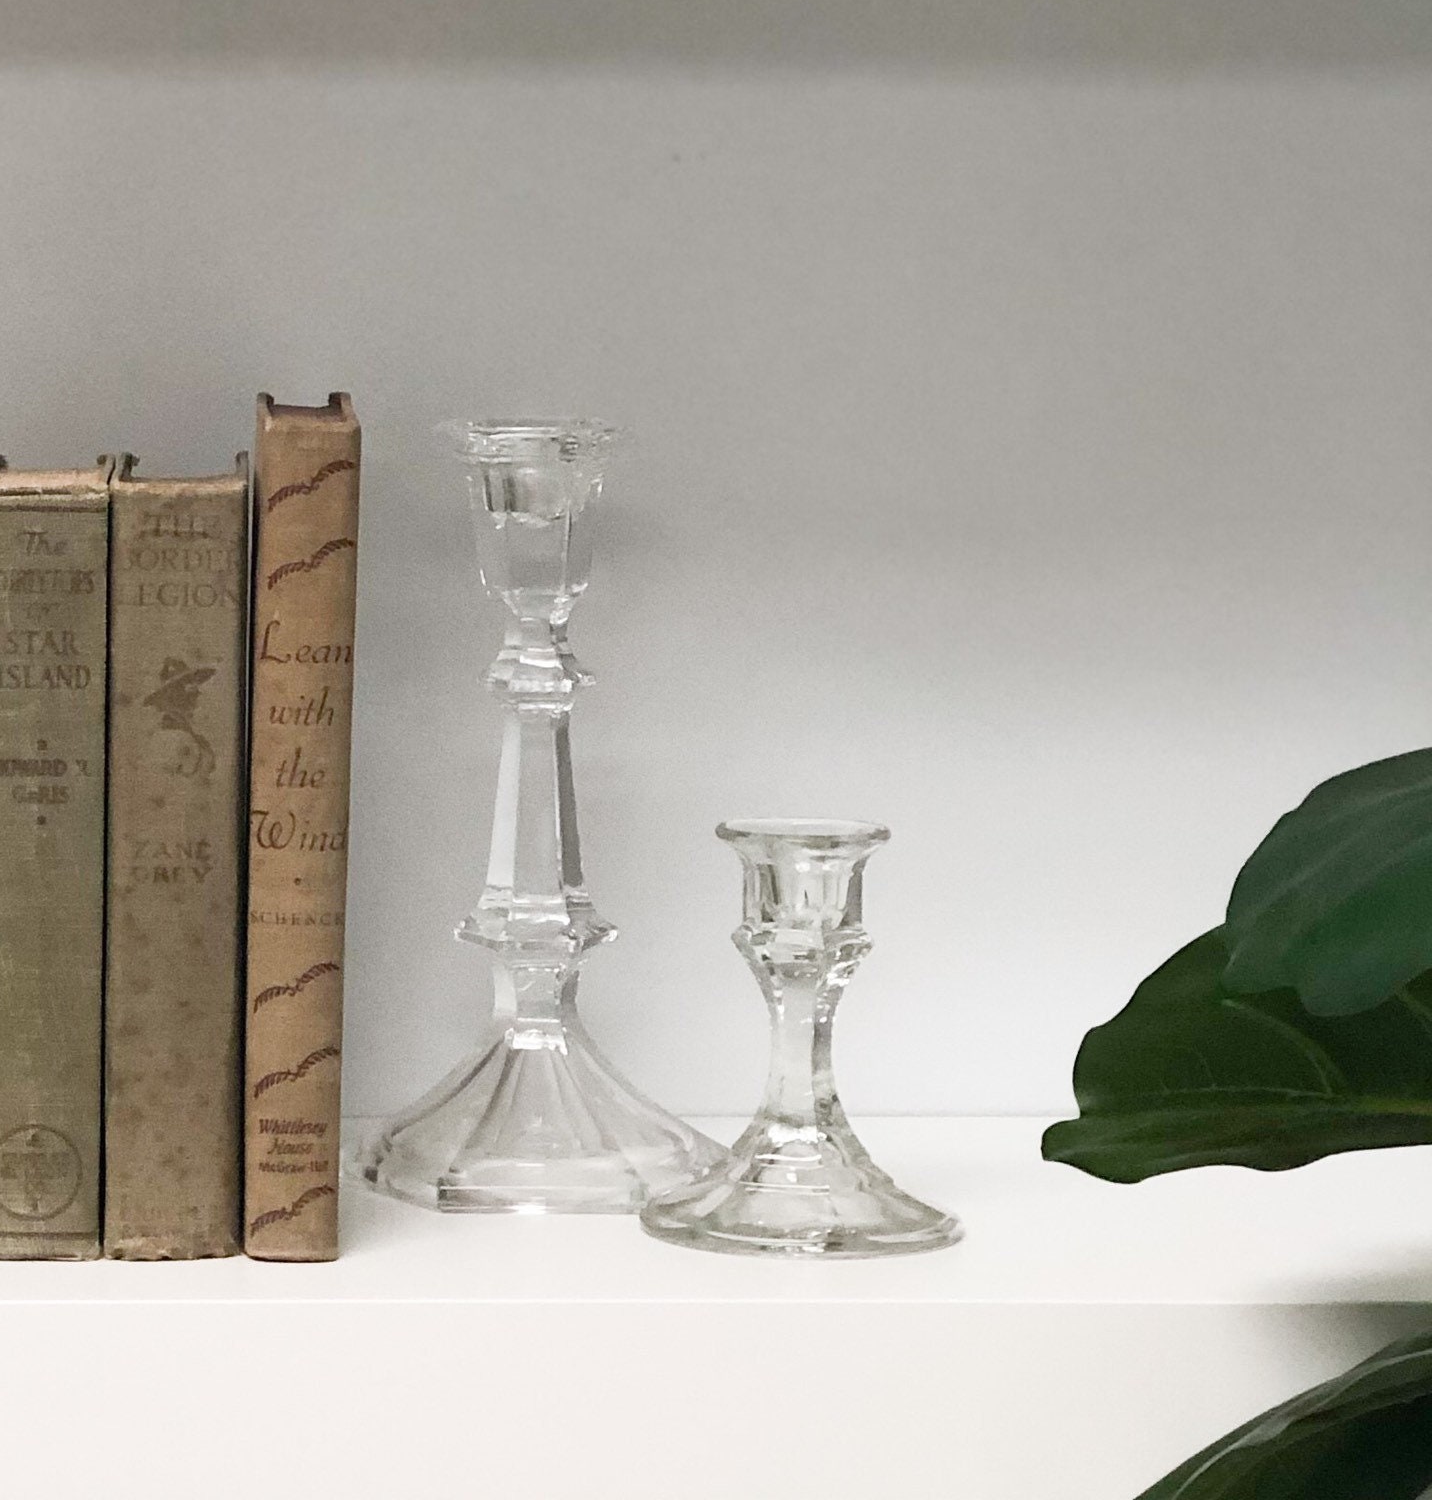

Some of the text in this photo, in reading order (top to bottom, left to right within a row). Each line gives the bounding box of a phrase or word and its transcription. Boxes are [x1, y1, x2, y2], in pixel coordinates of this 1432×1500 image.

[5, 629, 80, 657] STAR
[260, 620, 353, 665] Lean
[268, 686, 335, 726] with
[275, 745, 326, 789] the
